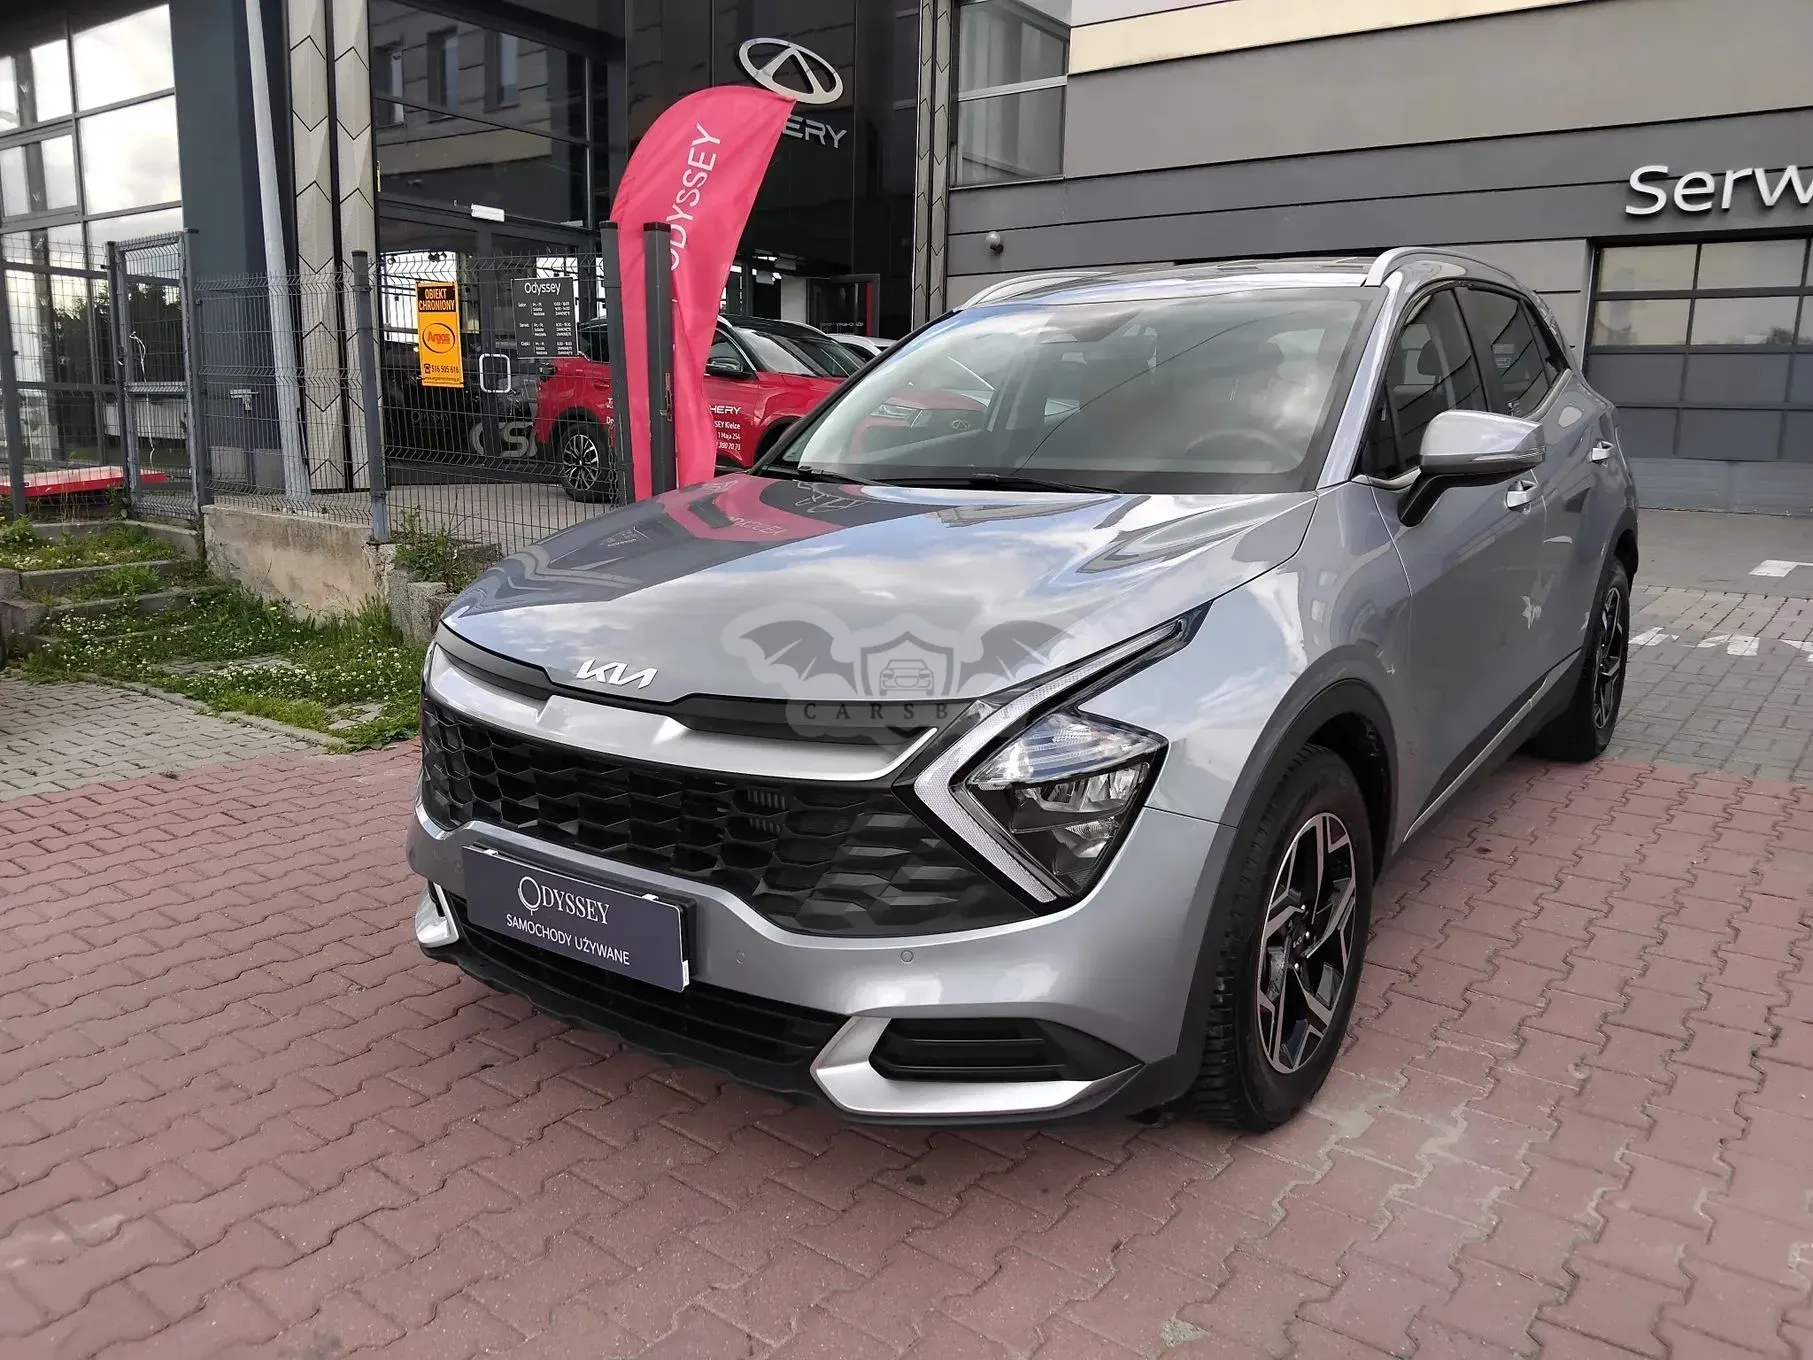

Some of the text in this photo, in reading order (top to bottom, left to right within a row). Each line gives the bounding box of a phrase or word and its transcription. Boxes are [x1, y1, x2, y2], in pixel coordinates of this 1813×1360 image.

[1625, 165, 1813, 215] Serw
[424, 288, 447, 299] OBIEKT
[524, 282, 561, 296] Odyssey
[418, 299, 455, 311] CHRONIONY
[575, 659, 659, 689] KIA
[518, 876, 610, 925] ODYSSEY
[506, 913, 631, 965] SAMOCHODY UŻYWANE
